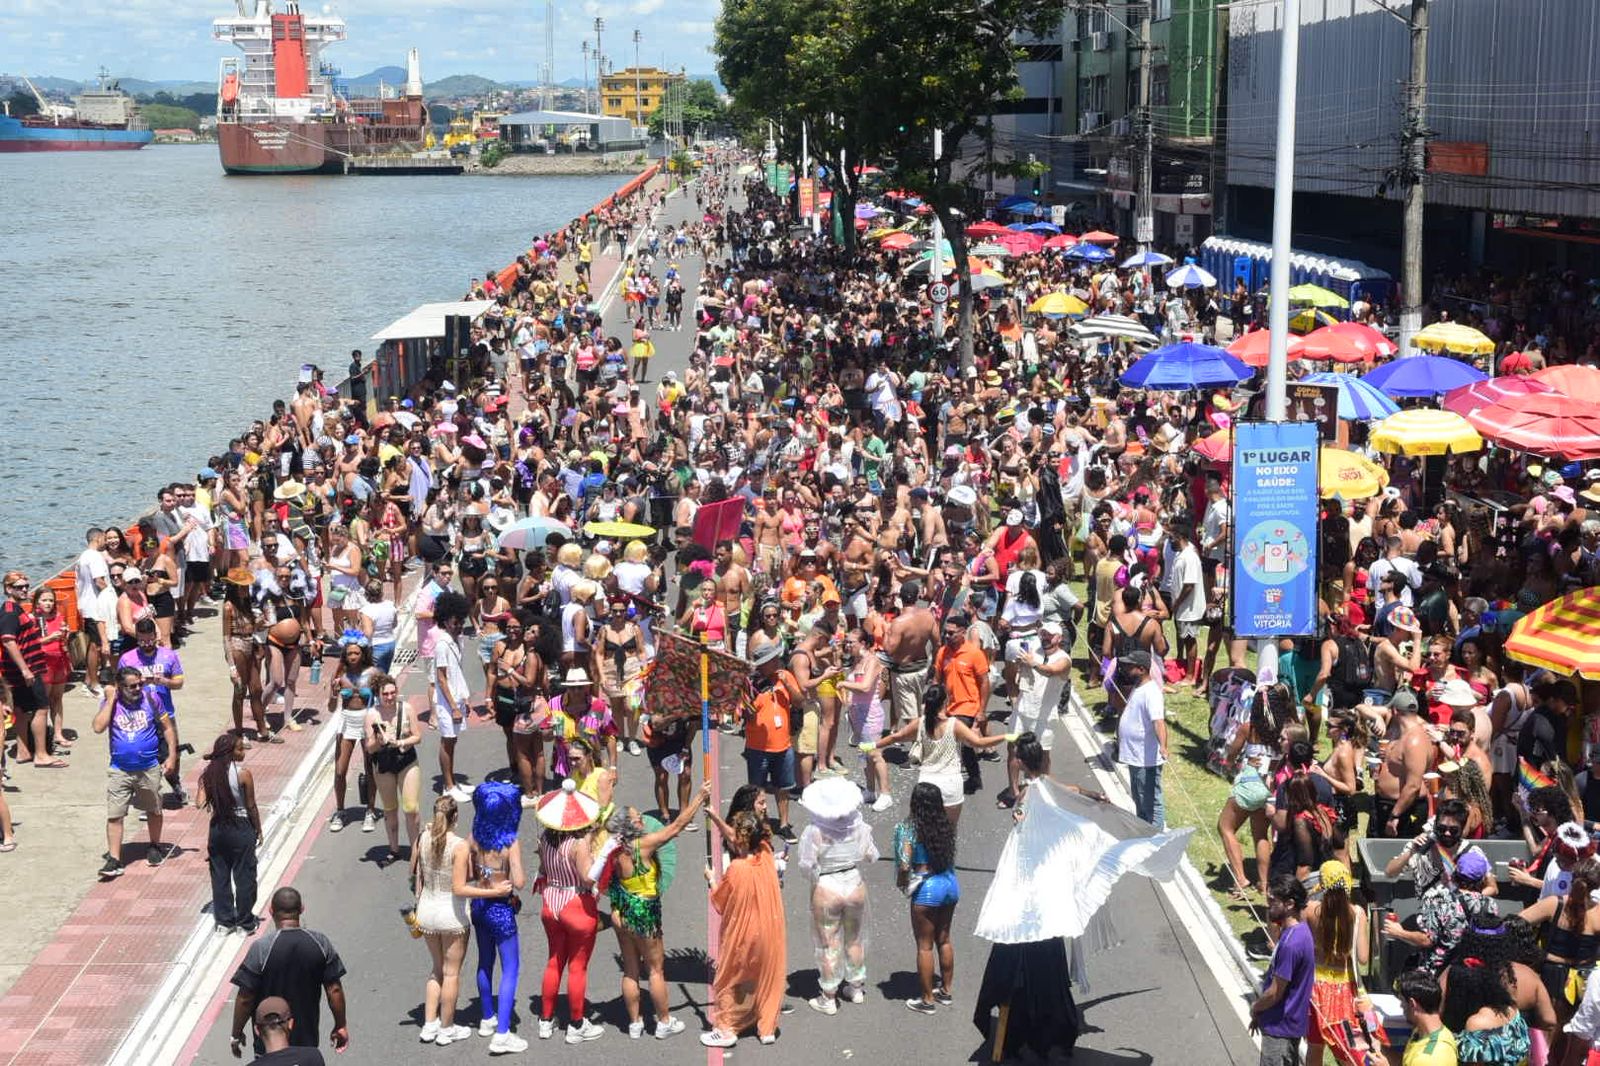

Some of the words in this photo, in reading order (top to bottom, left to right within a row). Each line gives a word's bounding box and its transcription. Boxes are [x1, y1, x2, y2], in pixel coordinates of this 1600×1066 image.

[932, 286, 947, 296] 60
[1243, 452, 1257, 464] 1º
[1260, 451, 1311, 463] LUGAR
[1256, 467, 1271, 476] NO
[1273, 466, 1298, 475] EIXO
[1257, 476, 1296, 487] SAÚDE:
[1254, 619, 1292, 629] VITÓRIA
